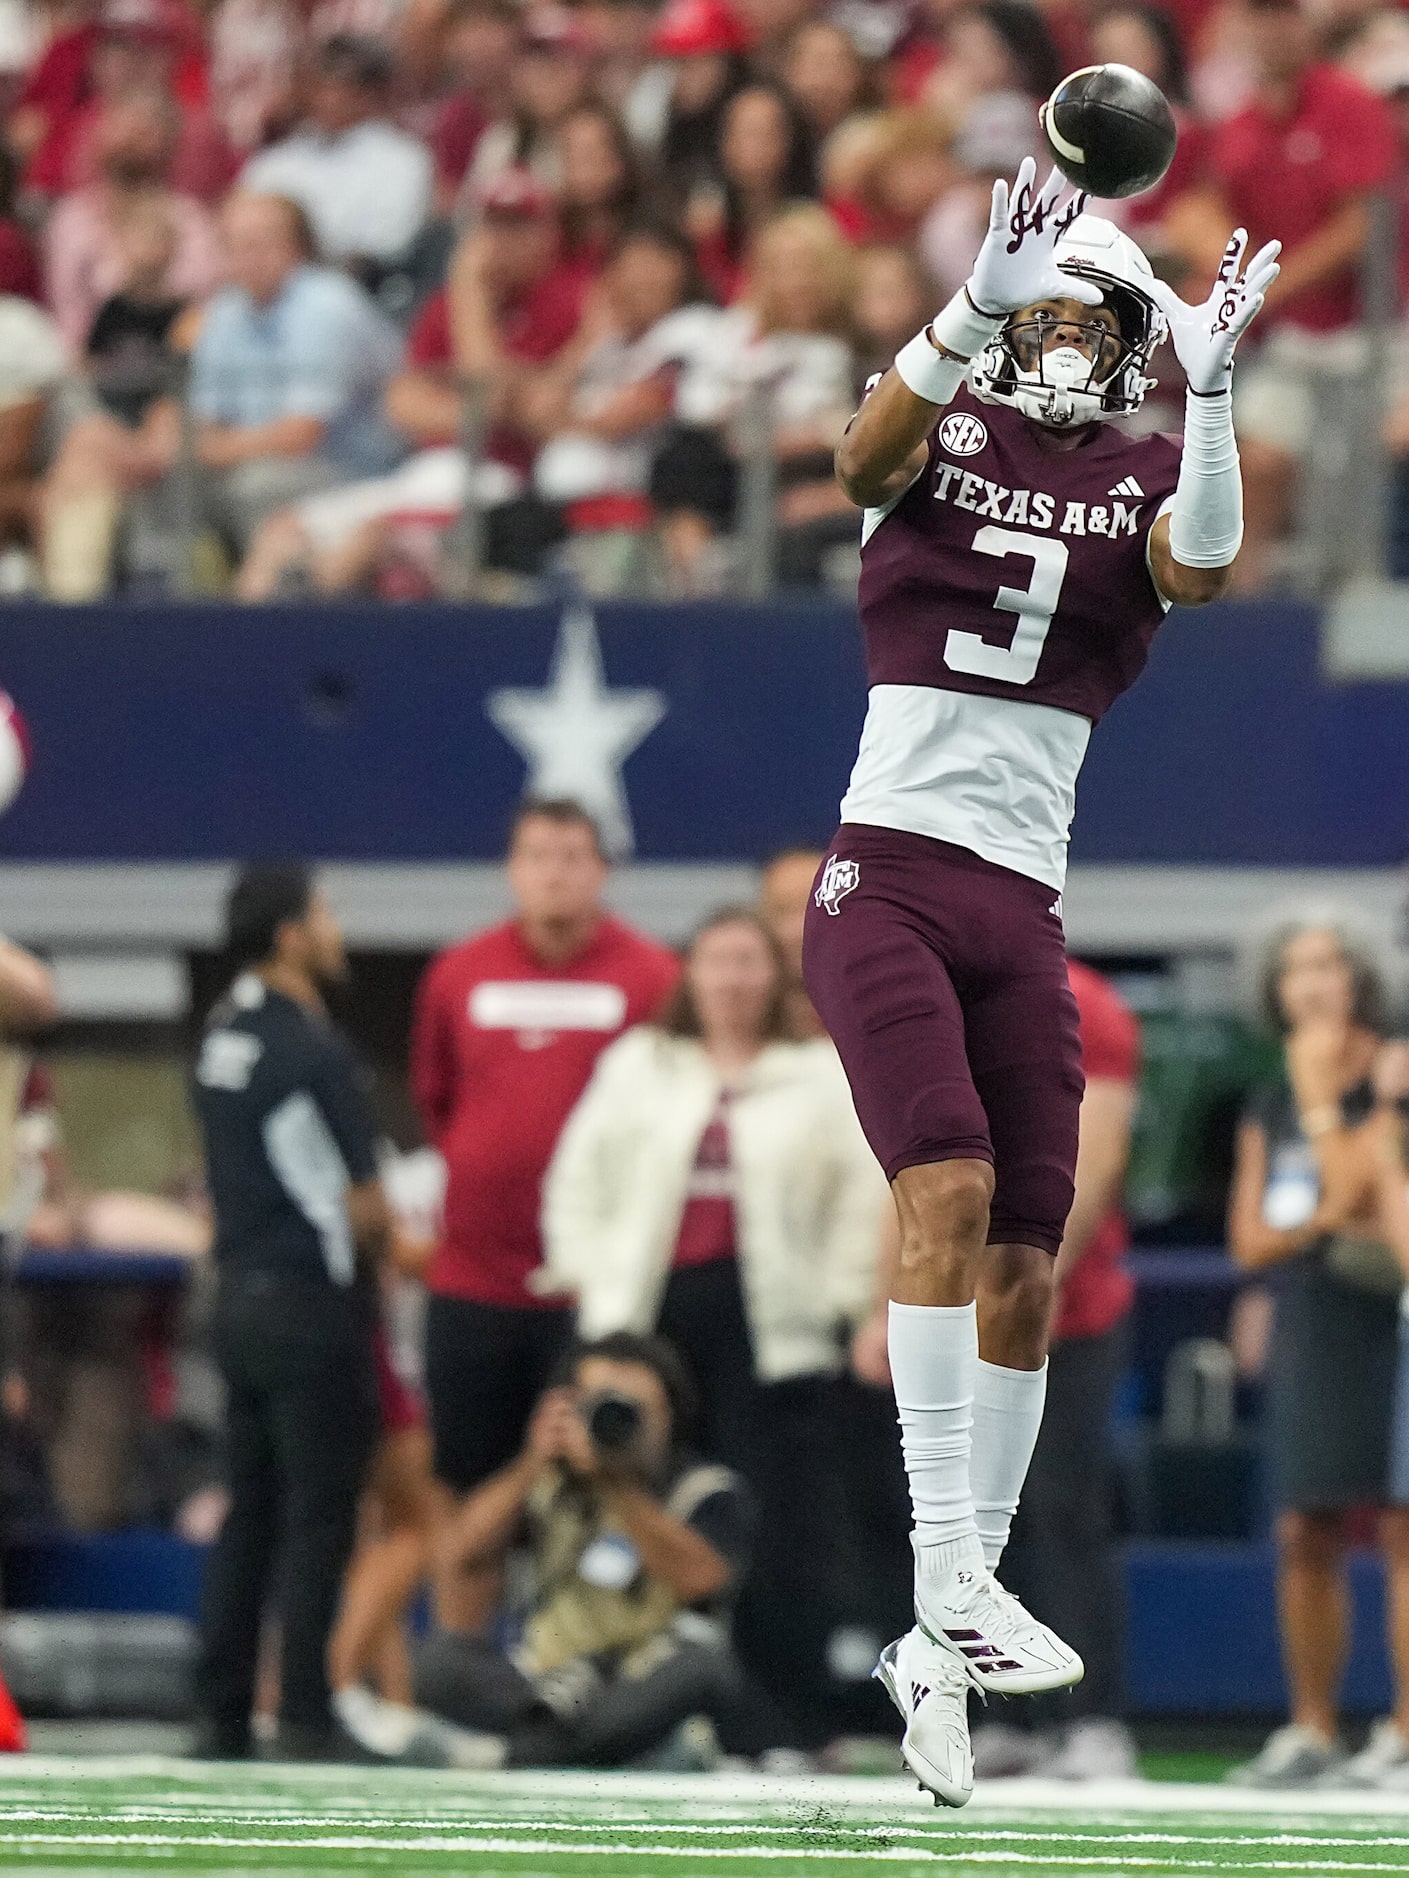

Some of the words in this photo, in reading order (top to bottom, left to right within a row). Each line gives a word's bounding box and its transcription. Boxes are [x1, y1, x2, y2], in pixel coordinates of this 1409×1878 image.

[942, 416, 985, 453] SEC
[933, 461, 1056, 529] TEXAS
[1059, 501, 1143, 540] A&M
[943, 524, 1070, 686] 3
